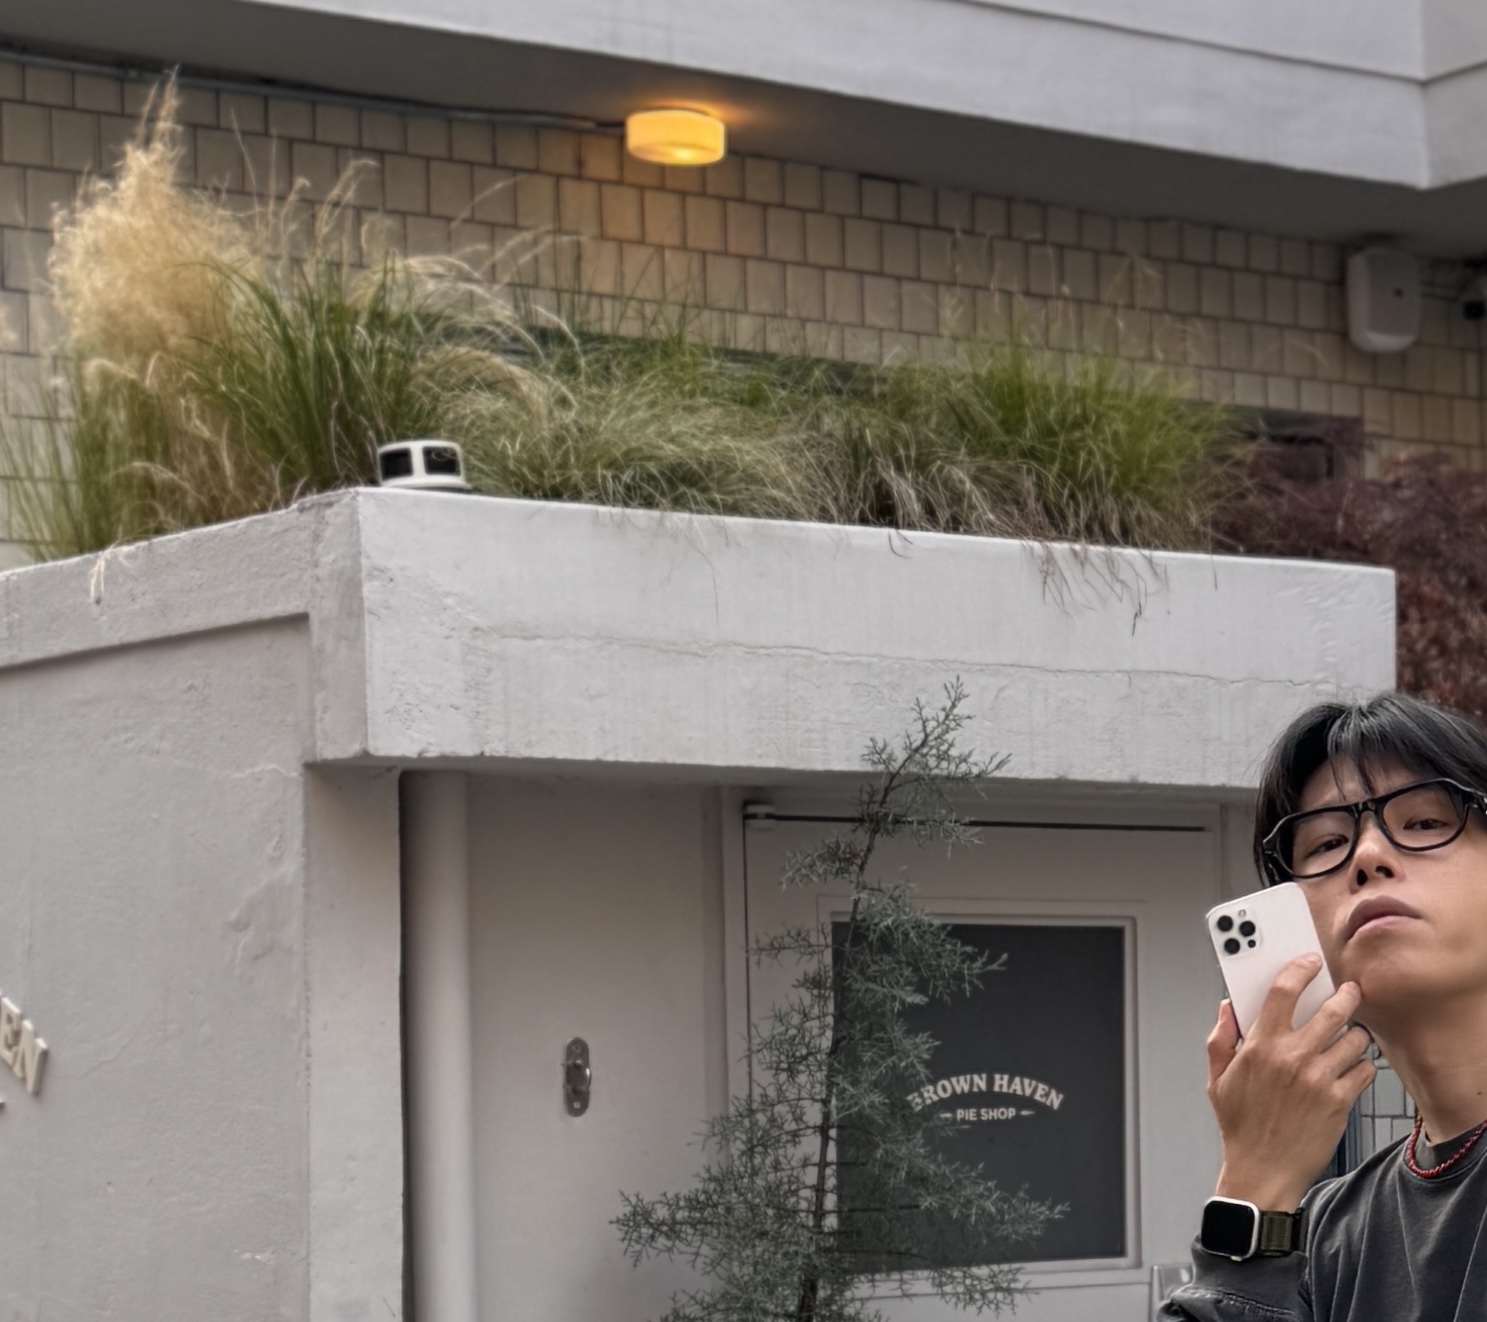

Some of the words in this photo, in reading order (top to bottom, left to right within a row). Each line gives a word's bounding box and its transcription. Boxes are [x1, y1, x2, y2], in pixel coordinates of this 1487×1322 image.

[906, 1074, 987, 1112] BROWN
[993, 1074, 1064, 1110] HAVEN
[956, 1109, 978, 1121] PIE
[980, 1108, 1016, 1121] SHOP
